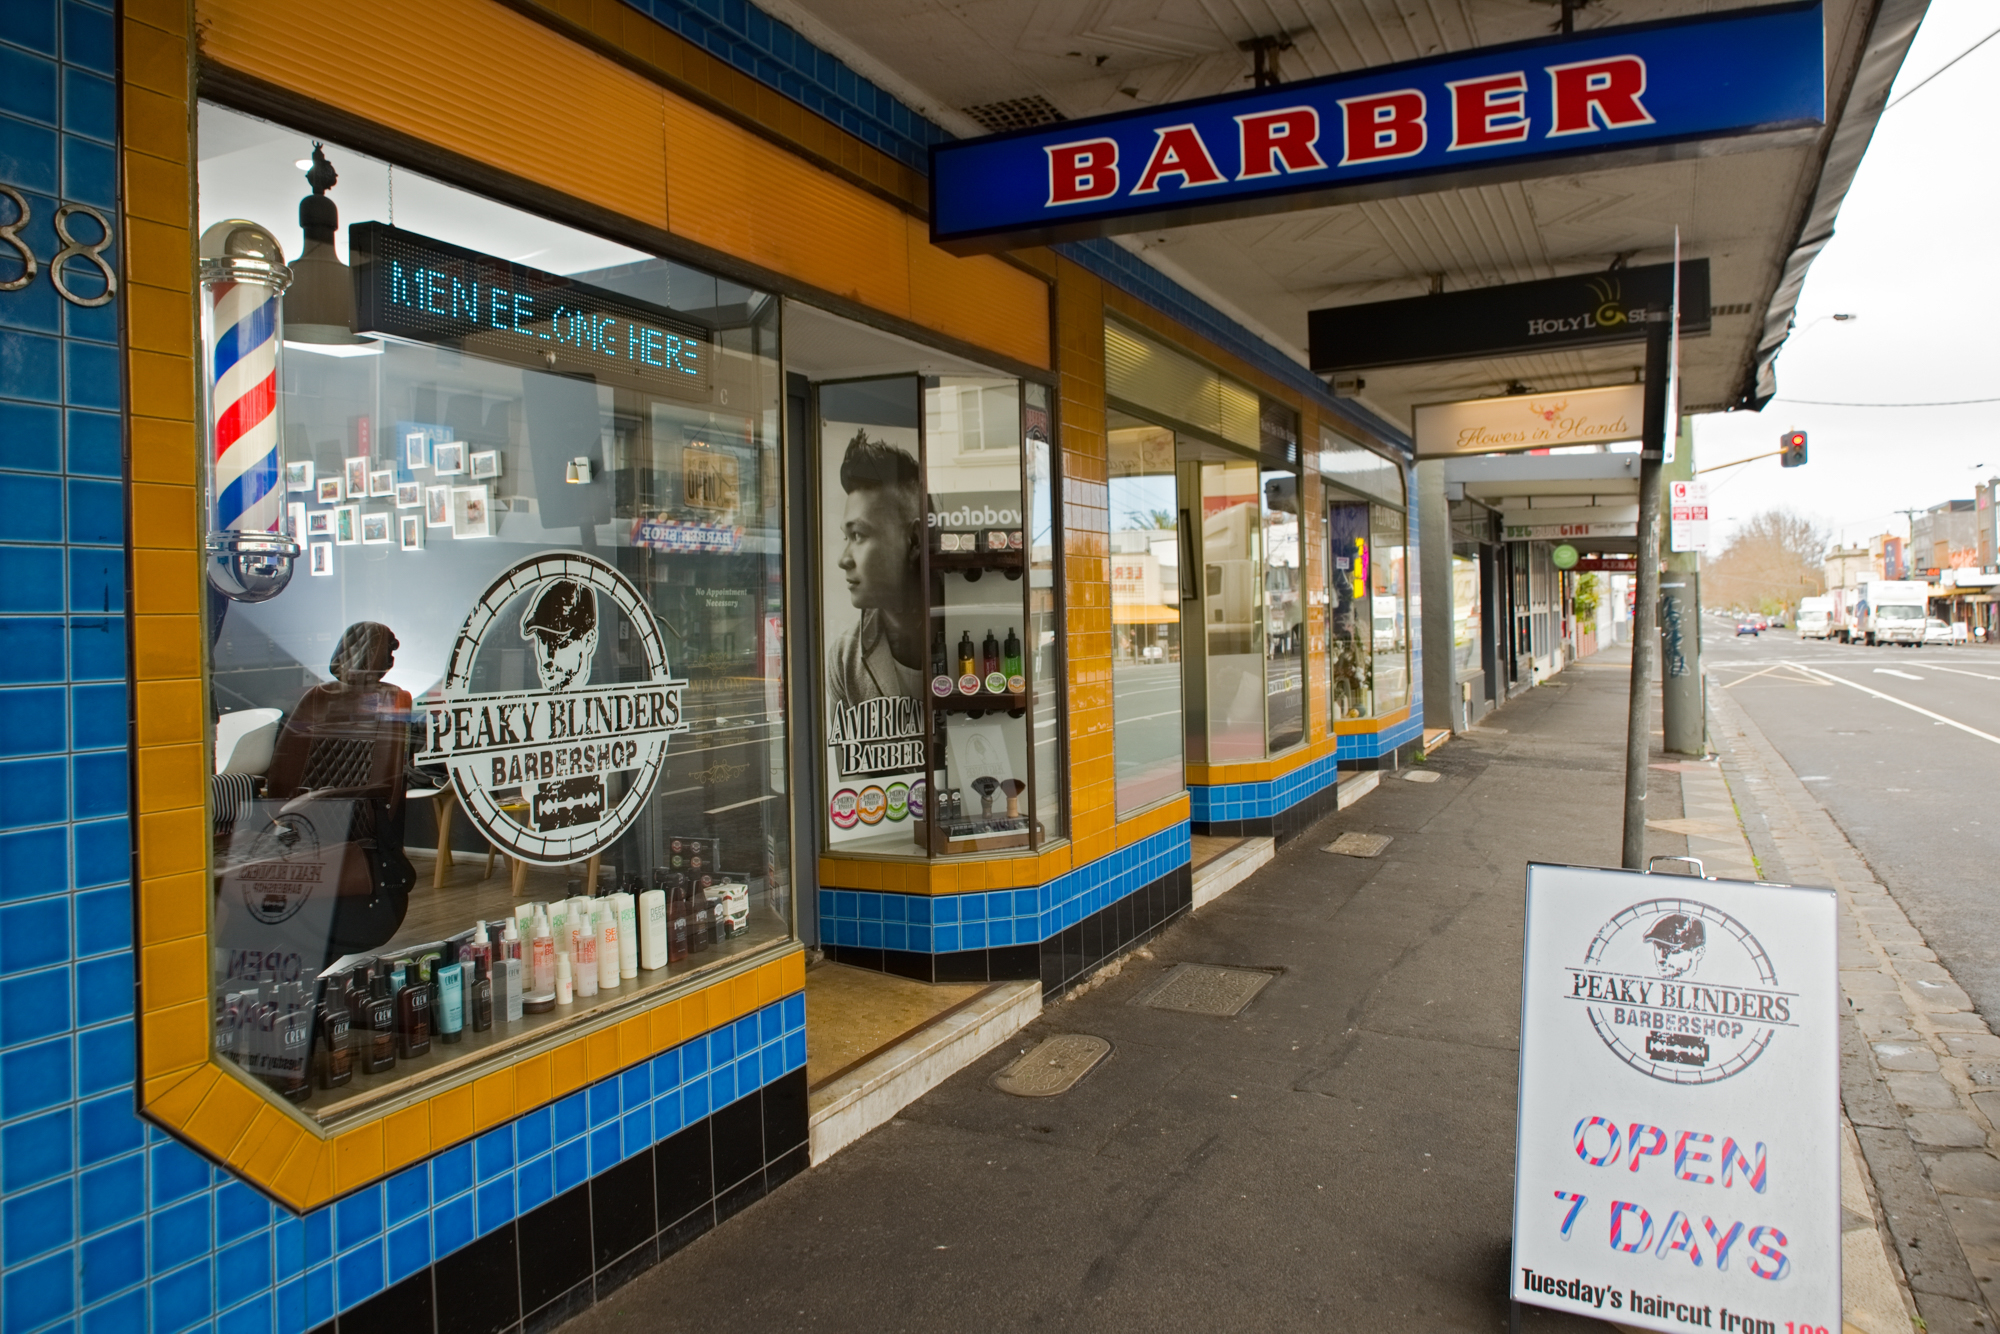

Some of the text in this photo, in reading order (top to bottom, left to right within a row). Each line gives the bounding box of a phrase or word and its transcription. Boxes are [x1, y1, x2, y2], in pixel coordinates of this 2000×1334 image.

[1043, 54, 1656, 209] BARBER
[392, 260, 478, 323] MEN
[629, 323, 697, 375] HERE
[1528, 315, 1582, 336] HOLY
[1456, 415, 1629, 447] Flowers in Hands
[687, 469, 716, 502] OPEN
[695, 588, 748, 598] No Appointment
[705, 599, 739, 608] Necessary
[429, 689, 680, 753] PEAKY BLINDERS
[491, 740, 638, 787] BARBERSHOP
[841, 740, 925, 777] BARBER
[444, 973, 459, 986] CREW
[412, 994, 427, 1008] CREW
[1572, 972, 1791, 1022] PEAKY BLINDERS
[334, 1021, 350, 1036] CREW
[374, 1009, 392, 1023] CREW
[1614, 1007, 1744, 1040] BARBERSHOP
[216, 1031, 234, 1048] REW
[284, 1027, 307, 1045] CREW
[1573, 1115, 1767, 1194] OPEN
[1554, 1190, 1791, 1281] 7 DAYS
[1521, 1268, 1776, 1334] Tuesday's haircut from
